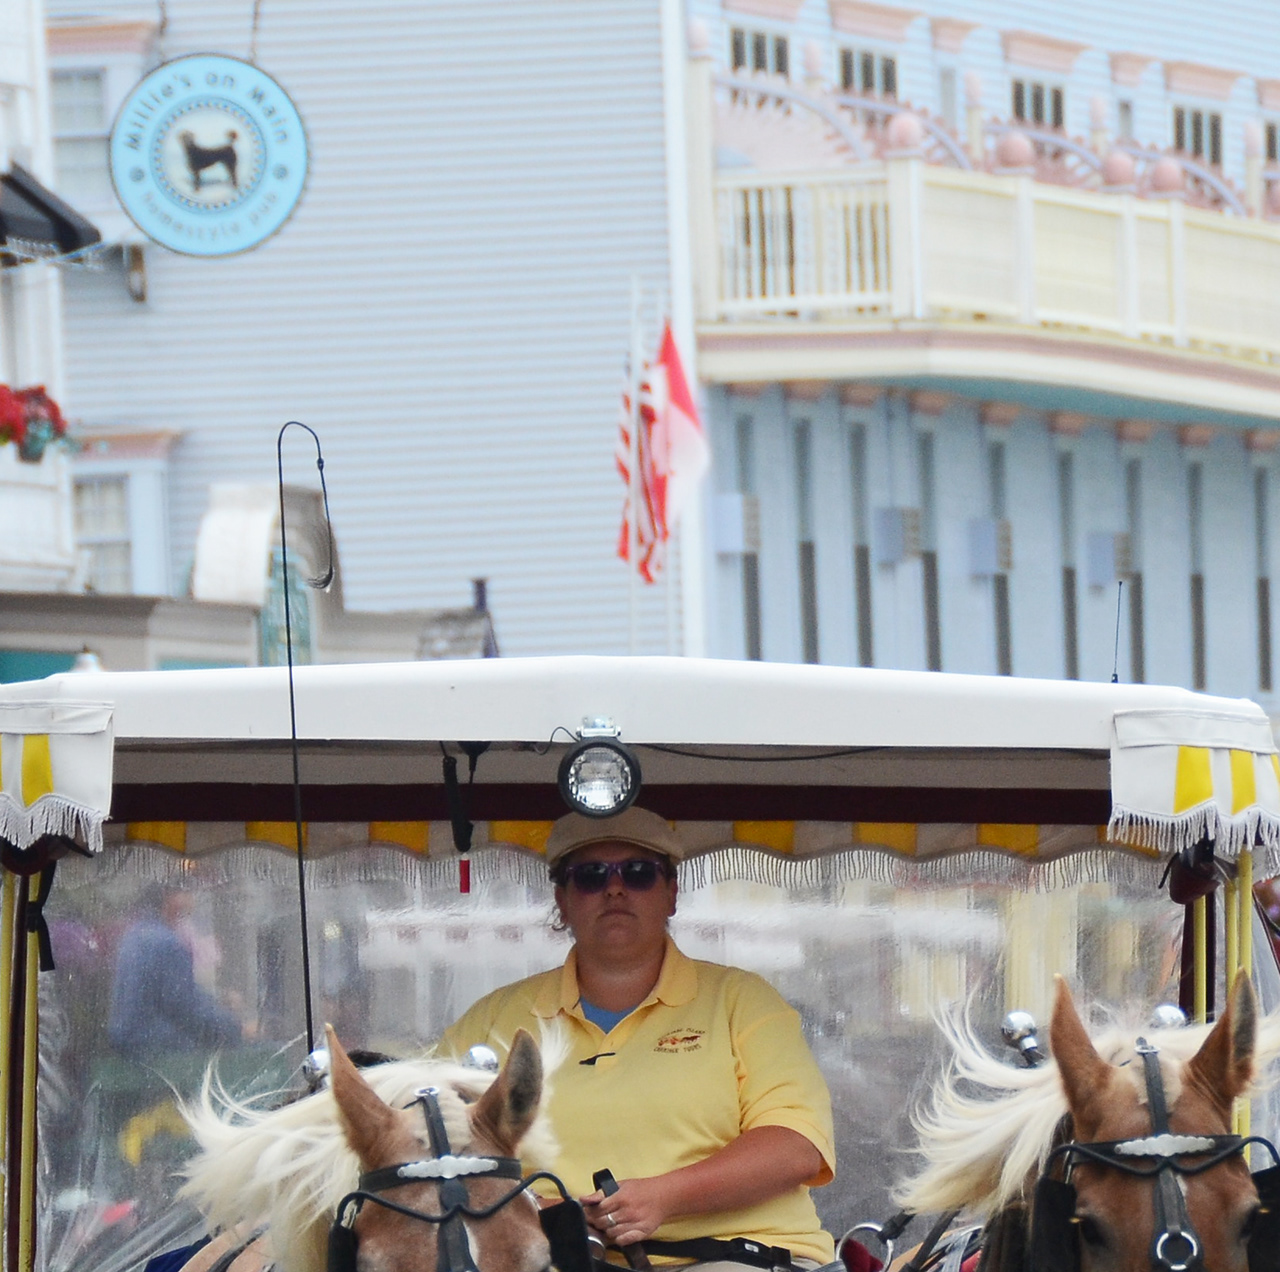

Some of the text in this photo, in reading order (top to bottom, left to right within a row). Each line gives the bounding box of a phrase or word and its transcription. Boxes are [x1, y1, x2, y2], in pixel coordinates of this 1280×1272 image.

[125, 72, 288, 150] Millie's on Main
